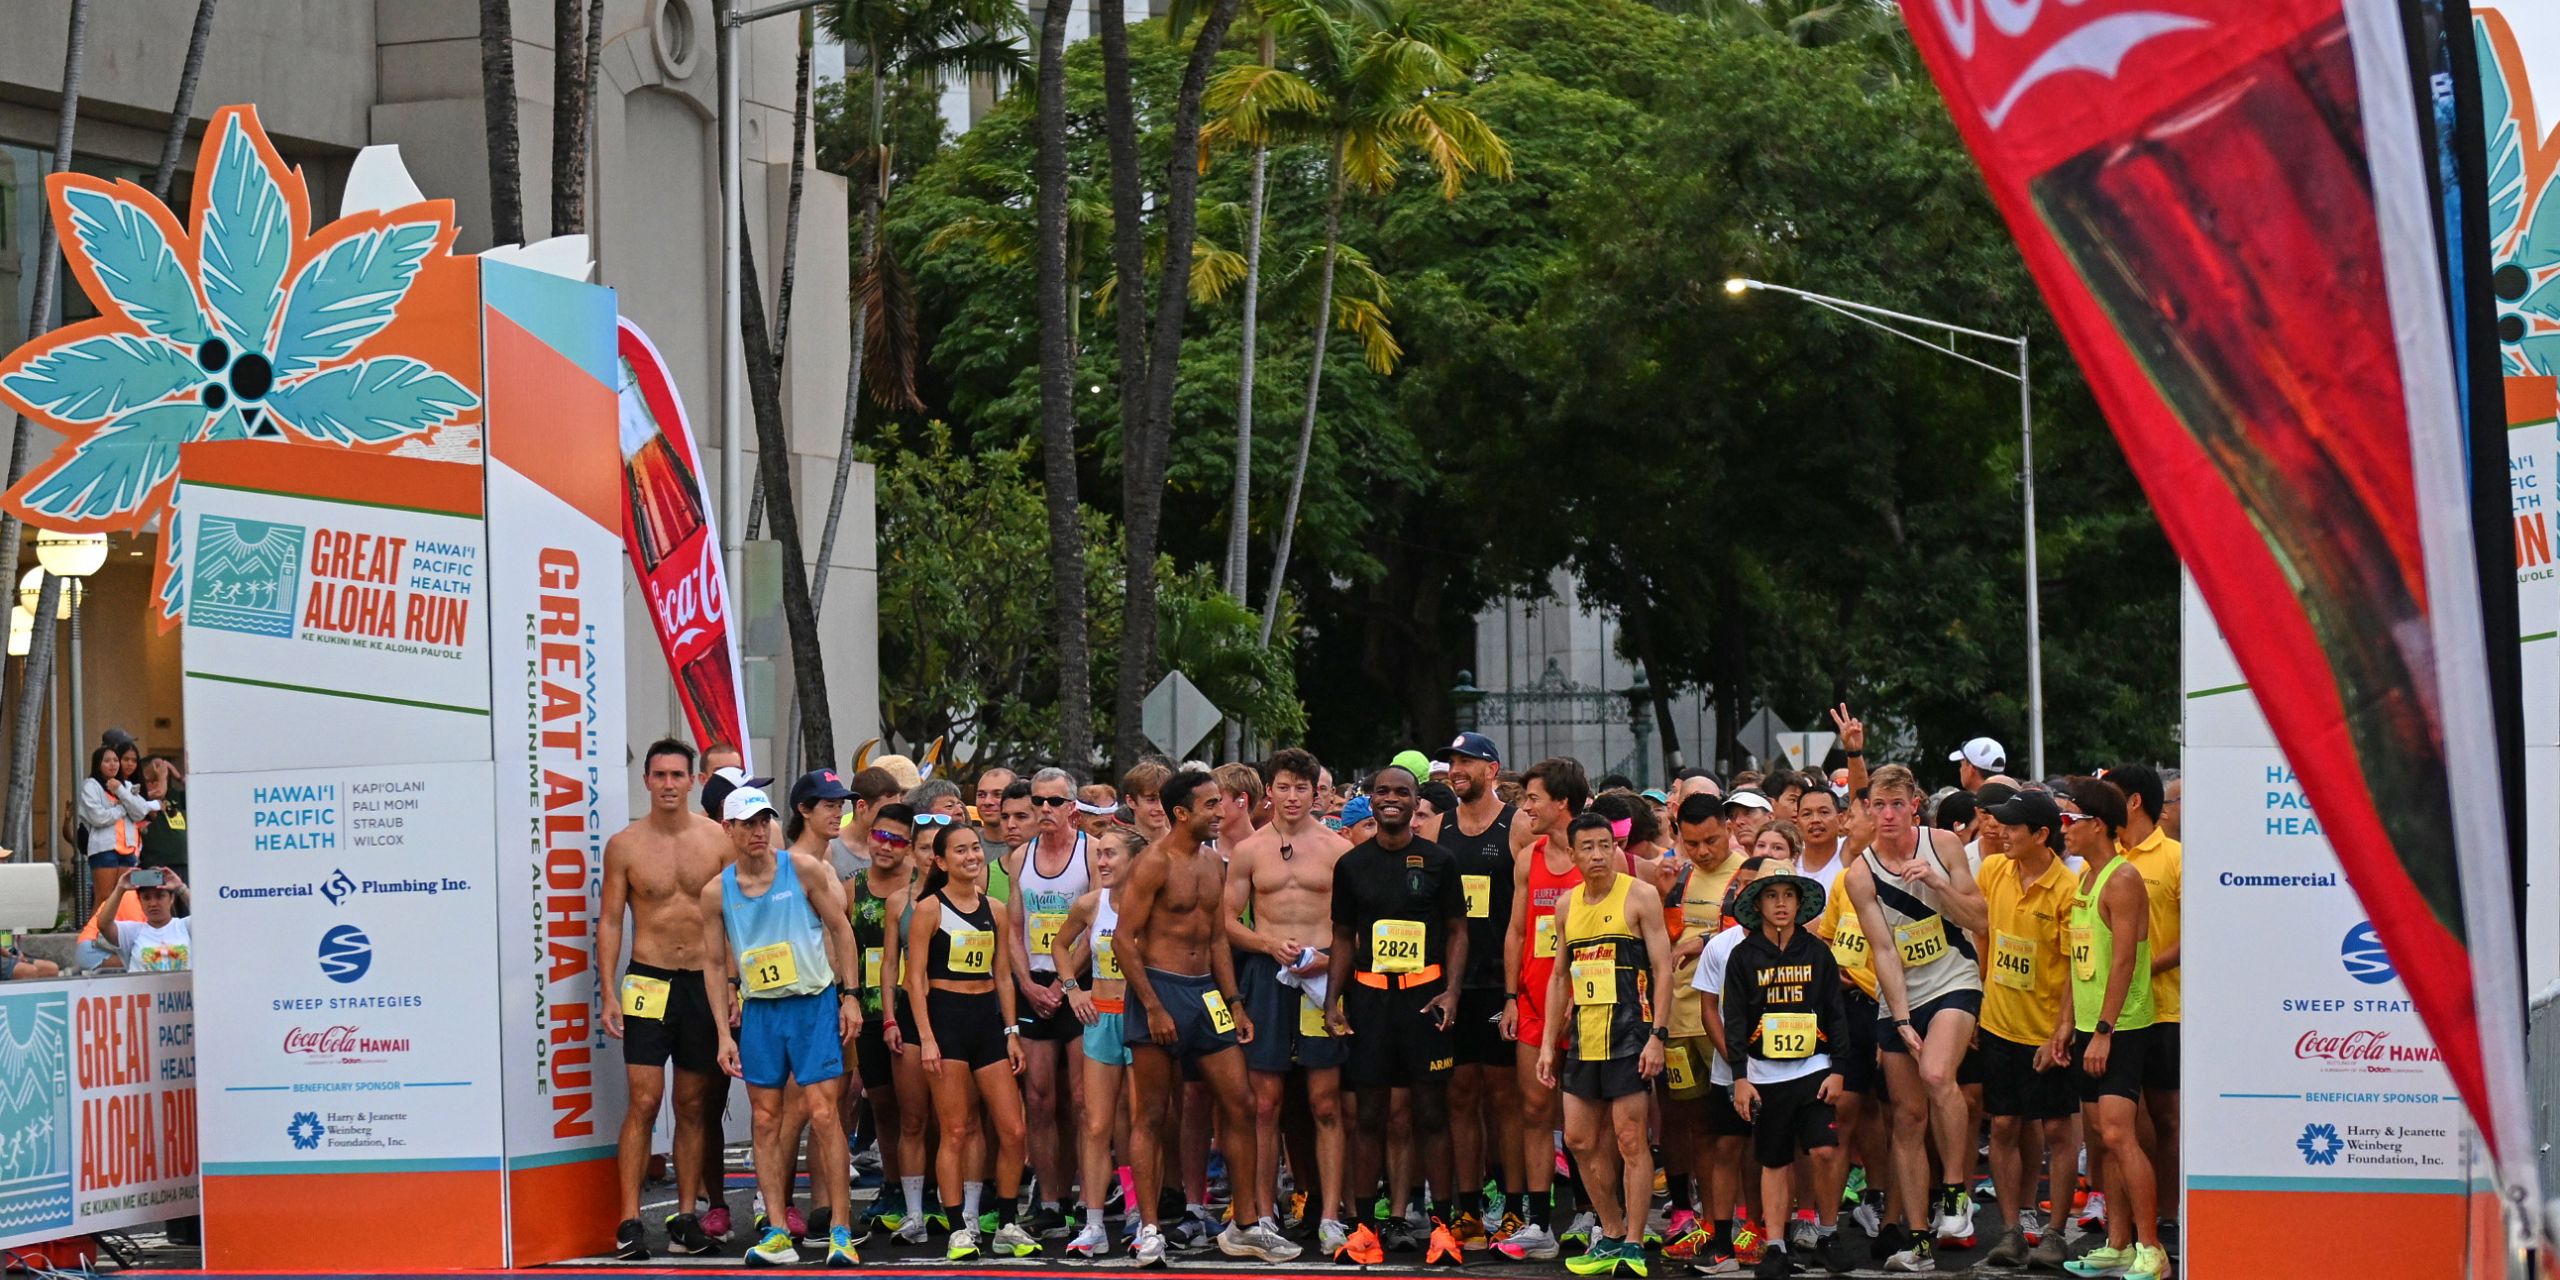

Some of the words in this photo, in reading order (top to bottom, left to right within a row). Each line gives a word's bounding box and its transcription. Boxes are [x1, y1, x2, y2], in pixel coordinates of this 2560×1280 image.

[310, 528, 407, 585] GREAT
[413, 558, 473, 577] PACIFIC
[410, 576, 471, 595] HEALTH
[303, 581, 398, 639] ALOHA
[404, 593, 469, 647] RUN
[526, 613, 536, 651] KE
[302, 632, 315, 641] KE
[317, 634, 351, 646] KUKINI
[352, 638, 367, 648] ME
[370, 641, 384, 650] KE
[385, 642, 418, 655] ALOHA
[538, 547, 582, 761] GREAT
[352, 800, 380, 812] PALI
[384, 799, 419, 811] MOMI
[254, 808, 335, 828] PACIFIC
[353, 817, 404, 829] STRAUB
[255, 832, 335, 851] HEALTH
[354, 834, 404, 847] WILCOX
[530, 817, 541, 855] KE
[588, 766, 603, 898] PACIFIC
[543, 768, 589, 984] ALOHA
[2219, 872, 2336, 887] Commercial
[219, 883, 313, 900] Commercial
[361, 878, 438, 894] Plumbing
[441, 877, 471, 891] Inc.
[532, 863, 544, 965] ALOHA
[1378, 940, 1418, 959] 2824
[1904, 935, 1943, 962] 2561
[965, 950, 983, 968] 49
[1996, 951, 2030, 975] 2446
[760, 965, 780, 984] 13
[1586, 981, 1594, 998] 9
[158, 990, 193, 1014] HAWA
[273, 999, 323, 1011] SWEEP
[330, 995, 422, 1009] STRATEGIES
[634, 995, 645, 1011] 6
[2282, 999, 2345, 1012] SWEEP
[76, 993, 151, 1090] GREAT
[159, 1024, 193, 1047] PACIF
[283, 1025, 361, 1055] Coca-Cola
[360, 1039, 410, 1053] HAWAII
[1774, 1034, 1804, 1052] 512
[2294, 1029, 2391, 1061] Coca-Cola
[2390, 1045, 2441, 1062] HAWA
[161, 1056, 196, 1081] HEALT
[536, 1038, 548, 1096] OLE
[549, 1002, 593, 1139] RUN
[1429, 1057, 1454, 1072] ARMY
[293, 1082, 352, 1093] BENEFICIARY
[355, 1081, 401, 1091] SPONSOR
[2306, 1092, 2380, 1104] BENEFICIARY
[2382, 1093, 2439, 1104] SPONSOR
[327, 1112, 354, 1124] Harry
[358, 1113, 366, 1121] &
[368, 1111, 408, 1122] Jeanette
[327, 1125, 372, 1136] Weinberg
[2347, 1126, 2382, 1138] Harry
[2385, 1126, 2395, 1137] &
[2398, 1126, 2446, 1138] Jeanette
[80, 1092, 157, 1193] ALOHA
[327, 1137, 385, 1148] Foundation,
[388, 1137, 407, 1147] Inc.
[2347, 1140, 2402, 1152] Weinberg
[2347, 1154, 2418, 1166] Foundation,
[2422, 1155, 2444, 1166] Inc.
